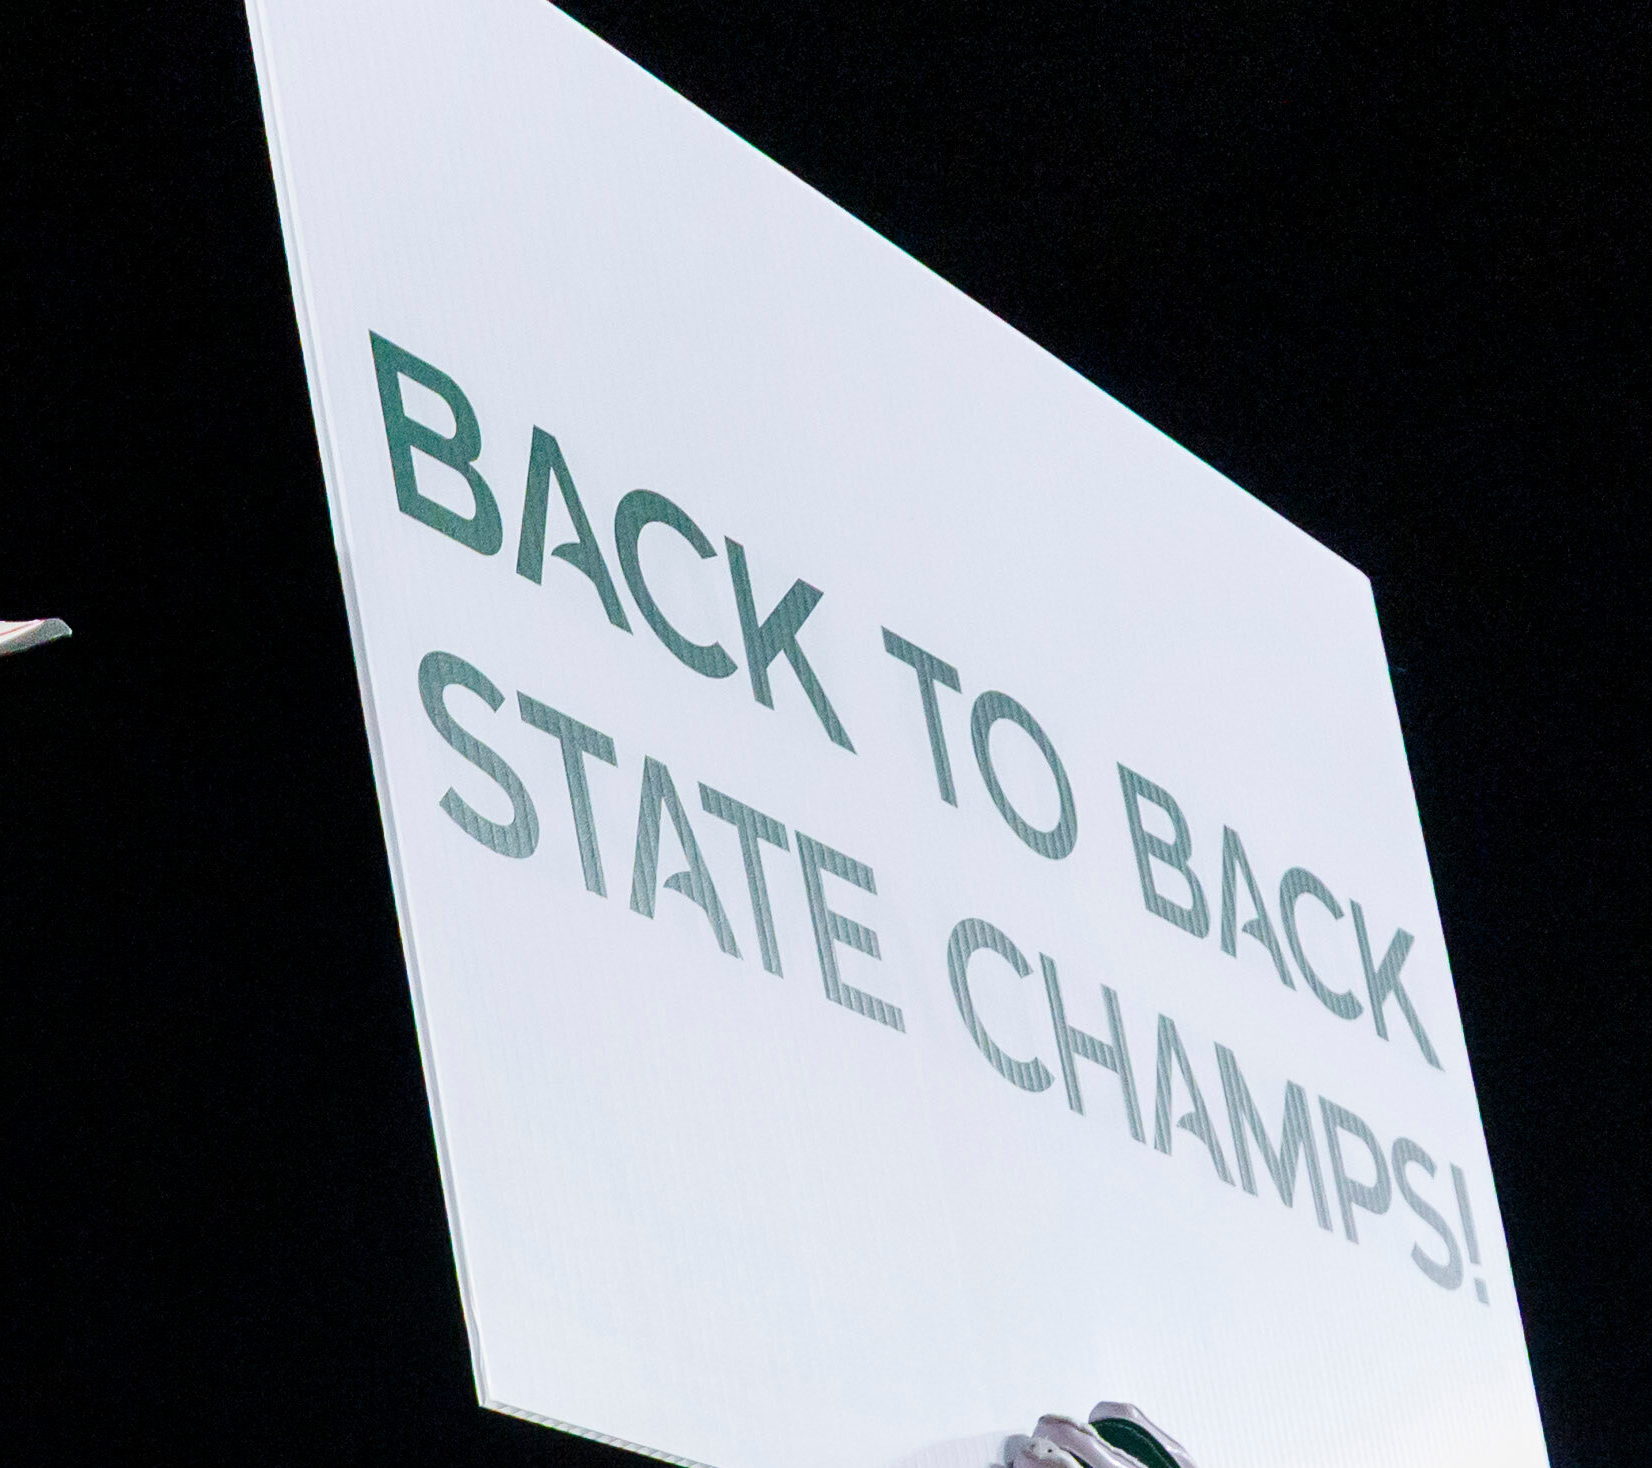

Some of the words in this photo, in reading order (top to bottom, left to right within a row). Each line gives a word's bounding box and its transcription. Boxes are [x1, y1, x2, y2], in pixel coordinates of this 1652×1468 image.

[368, 329, 856, 755] BACK
[881, 626, 1078, 861] TO
[1117, 761, 1445, 1072] BACK
[417, 649, 905, 1034] STATE
[946, 917, 1491, 1307] CHAMPS!
